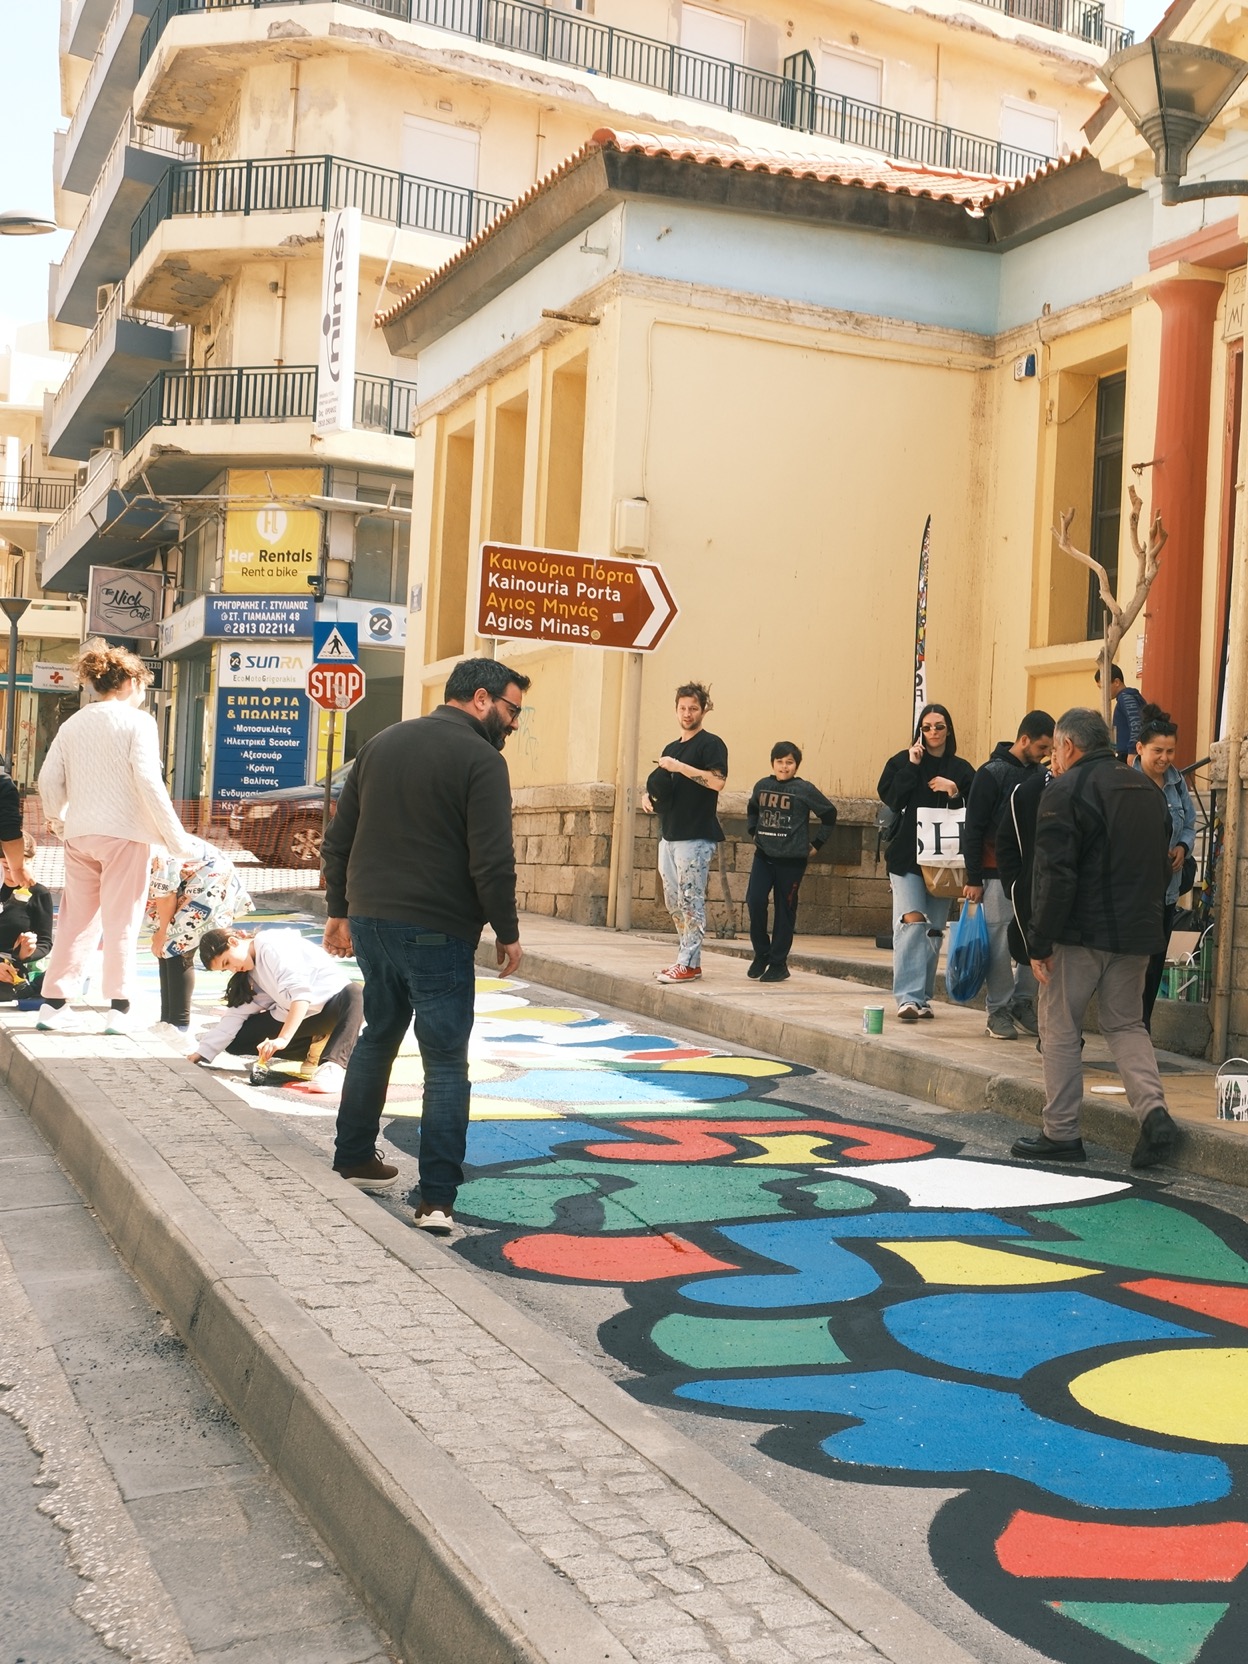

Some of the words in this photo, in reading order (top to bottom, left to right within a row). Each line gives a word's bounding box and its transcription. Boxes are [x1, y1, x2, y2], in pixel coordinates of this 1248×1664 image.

[229, 549, 254, 563] Her
[259, 549, 312, 563] Rentals
[241, 567, 265, 577] Rent
[267, 568, 274, 577] a
[276, 567, 298, 577] bike
[489, 553, 576, 579] Καινούρια
[583, 563, 635, 585] Πόρτα
[488, 572, 569, 597] Kainouria
[577, 582, 621, 602] Porta
[111, 589, 143, 606] Nick
[213, 601, 260, 610] ΓΡΗΓΟΡΑΚΗΣ
[270, 601, 309, 610] ΣΤΥΛΙΑΝΟΣ
[543, 598, 599, 622] Μηνάς
[289, 612, 301, 621] 48
[232, 623, 257, 634] 2813
[259, 623, 295, 634] 022114
[485, 612, 533, 632] Agios
[540, 617, 590, 637] Minas
[311, 671, 360, 699] STOP
[227, 695, 300, 707] ΕΜΠΟΡΙΑ
[227, 709, 236, 719] &
[241, 709, 299, 720] ΠΩΛΗΣΗ
[236, 724, 291, 735] Μοτοσυκλέτες
[226, 737, 266, 747] Ηλεκτρικά
[269, 738, 300, 747] Scooter
[243, 750, 282, 761] Αξεσουάρ
[249, 763, 275, 773] Κράνη
[243, 776, 279, 787] Βαλίτσες
